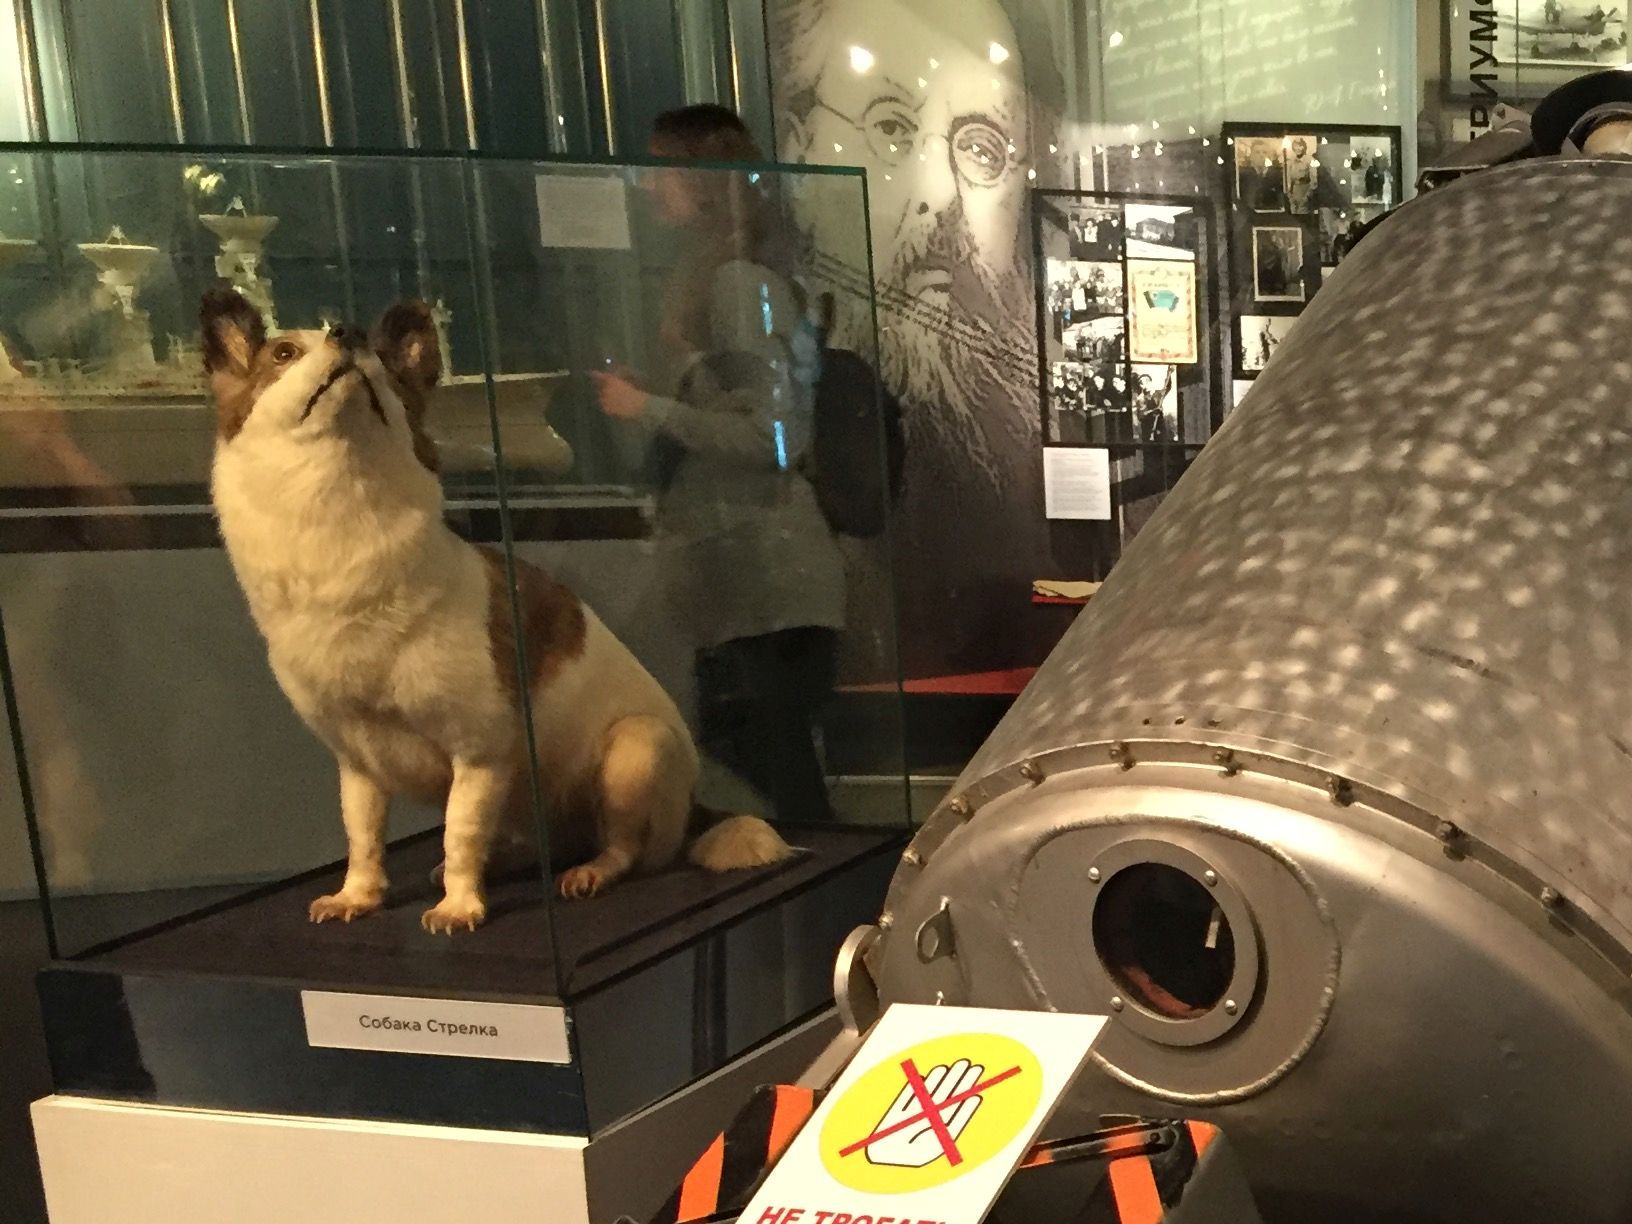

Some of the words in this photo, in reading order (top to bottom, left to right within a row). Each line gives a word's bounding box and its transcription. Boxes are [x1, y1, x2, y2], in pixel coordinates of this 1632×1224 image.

[1468, 0, 1498, 140] РИУМ
[358, 1014, 422, 1031] Собака
[427, 1019, 499, 1037] Стрелка
